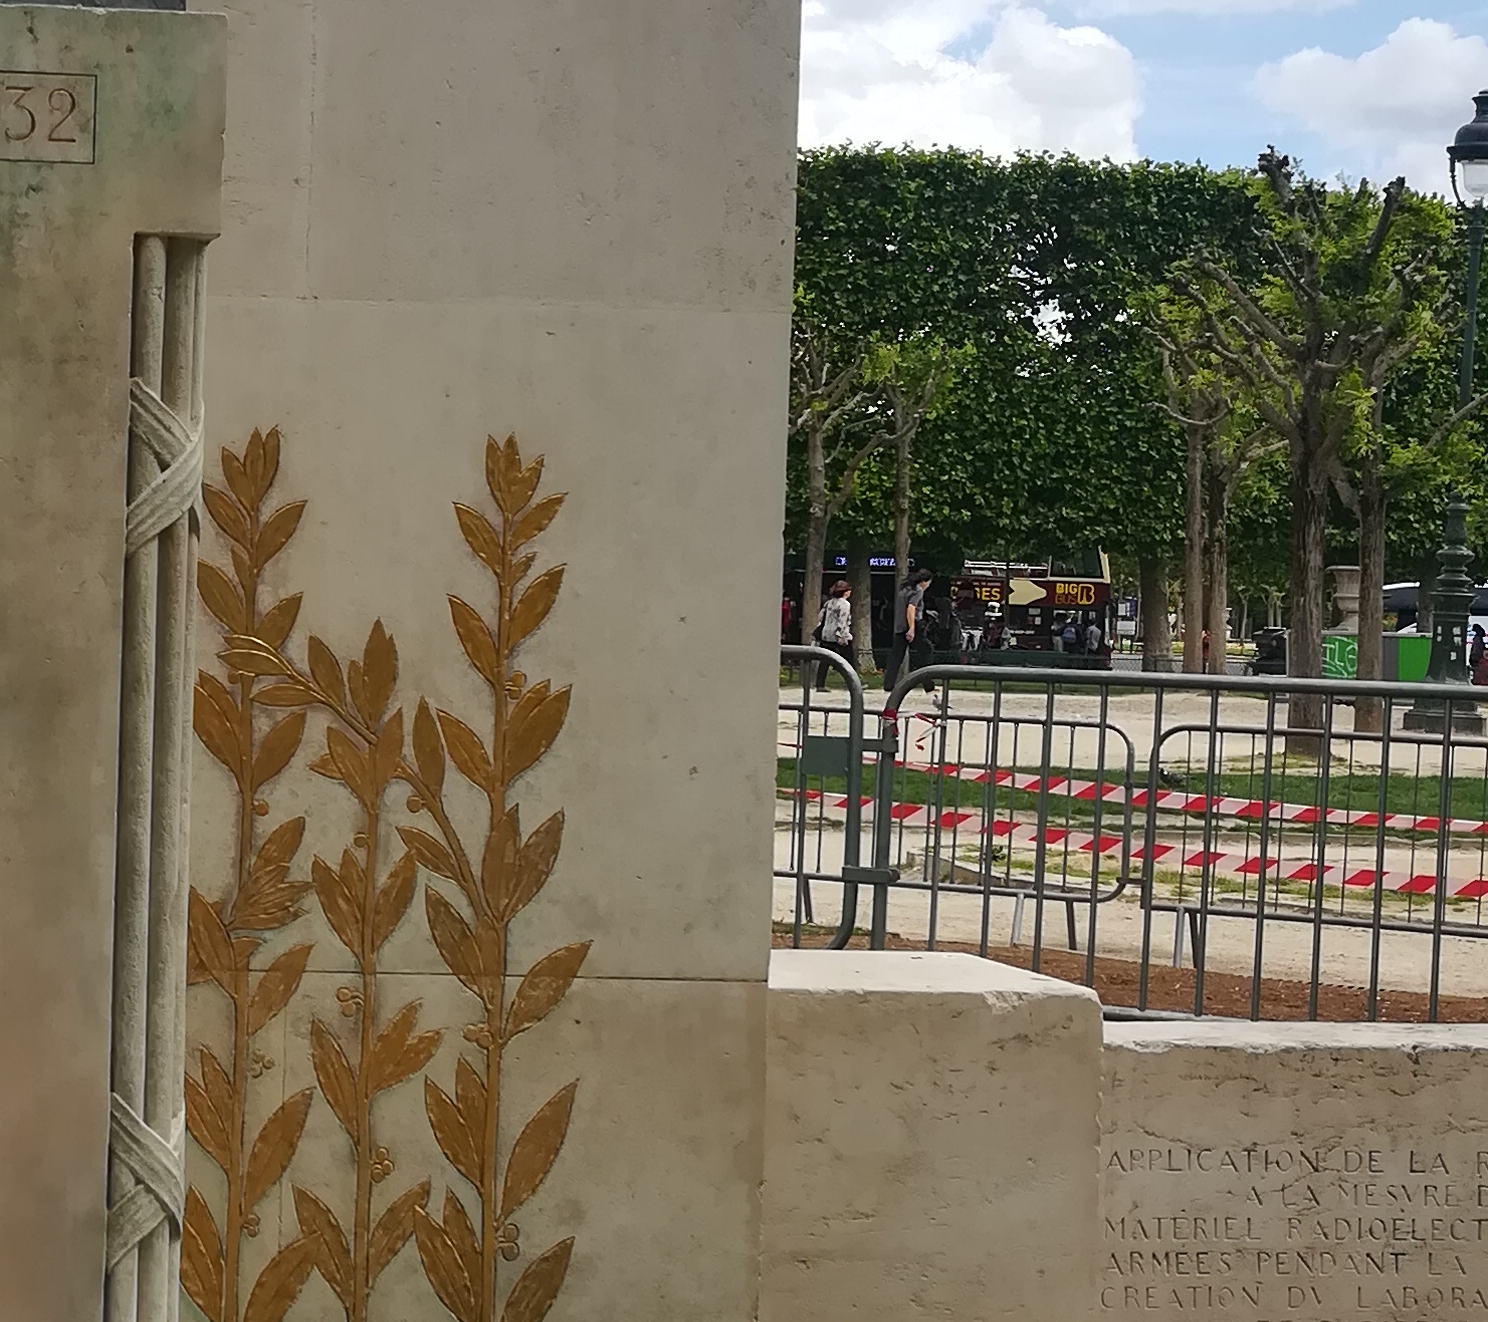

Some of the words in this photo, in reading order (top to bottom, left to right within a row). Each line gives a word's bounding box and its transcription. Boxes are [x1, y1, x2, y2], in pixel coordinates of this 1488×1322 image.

[1055, 583, 1078, 595] BIG
[1343, 1149, 1386, 1175] DE
[1409, 1150, 1450, 1176] LA
[1255, 1248, 1408, 1277] PENDANT
